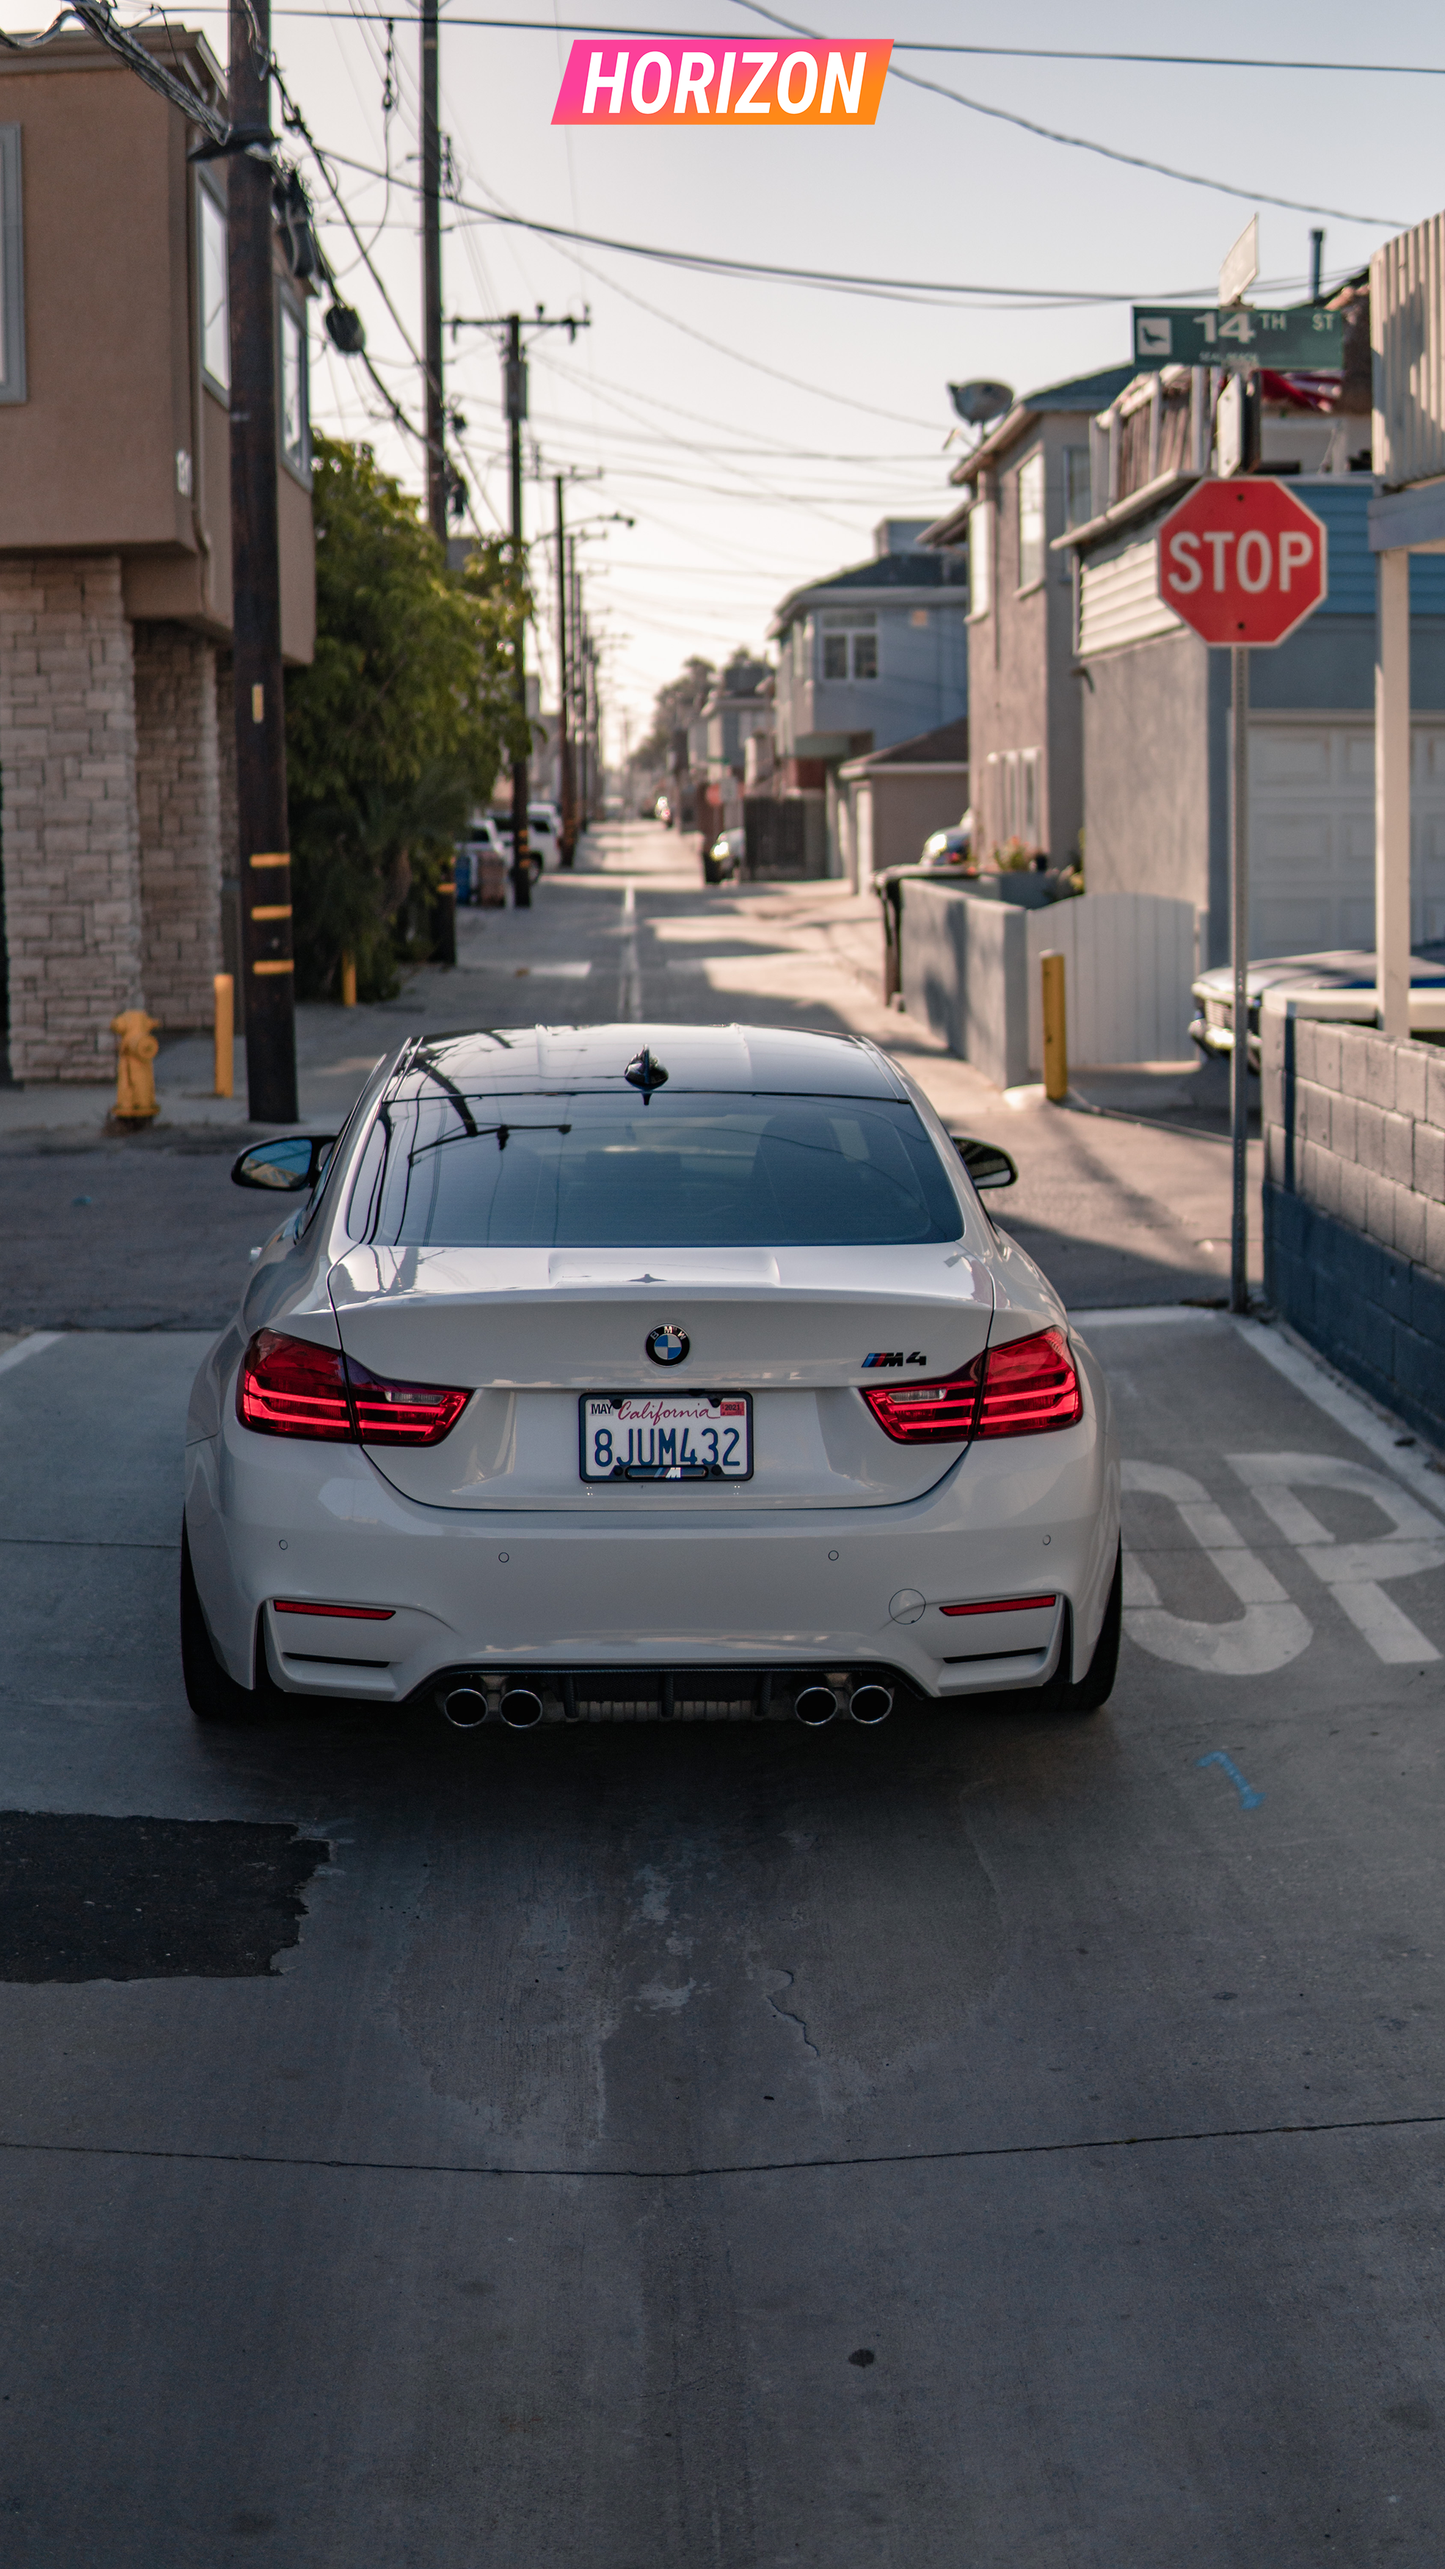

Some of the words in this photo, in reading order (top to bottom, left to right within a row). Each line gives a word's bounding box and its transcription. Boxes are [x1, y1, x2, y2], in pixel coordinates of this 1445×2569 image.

[1193, 312, 1287, 344] 14TH
[1312, 313, 1334, 331] ST
[1168, 530, 1314, 594] STOP
[650, 1326, 686, 1340] BMW
[879, 1352, 927, 1367] M4
[591, 1403, 613, 1415] MAY
[618, 1401, 720, 1426] California
[594, 1428, 740, 1467] 8JUM432
